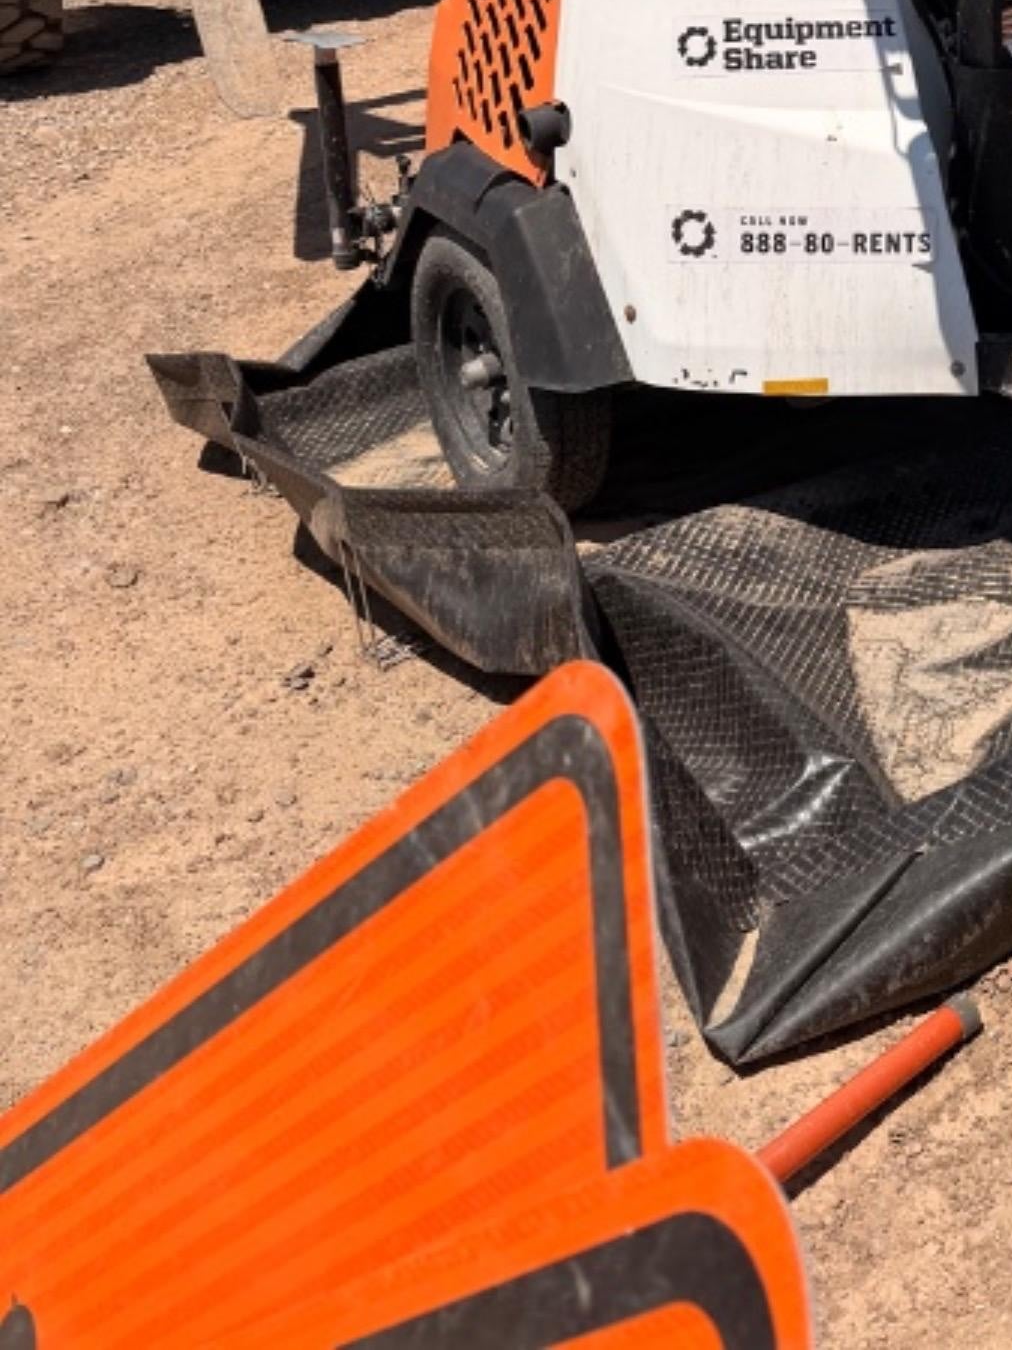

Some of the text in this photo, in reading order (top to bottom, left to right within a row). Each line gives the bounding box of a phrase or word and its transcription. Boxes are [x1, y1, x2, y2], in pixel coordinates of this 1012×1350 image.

[722, 17, 897, 46] Equipment
[722, 47, 817, 71] Share
[740, 216, 808, 226] CALL NOW
[740, 232, 931, 254] 888-80-RENTS
